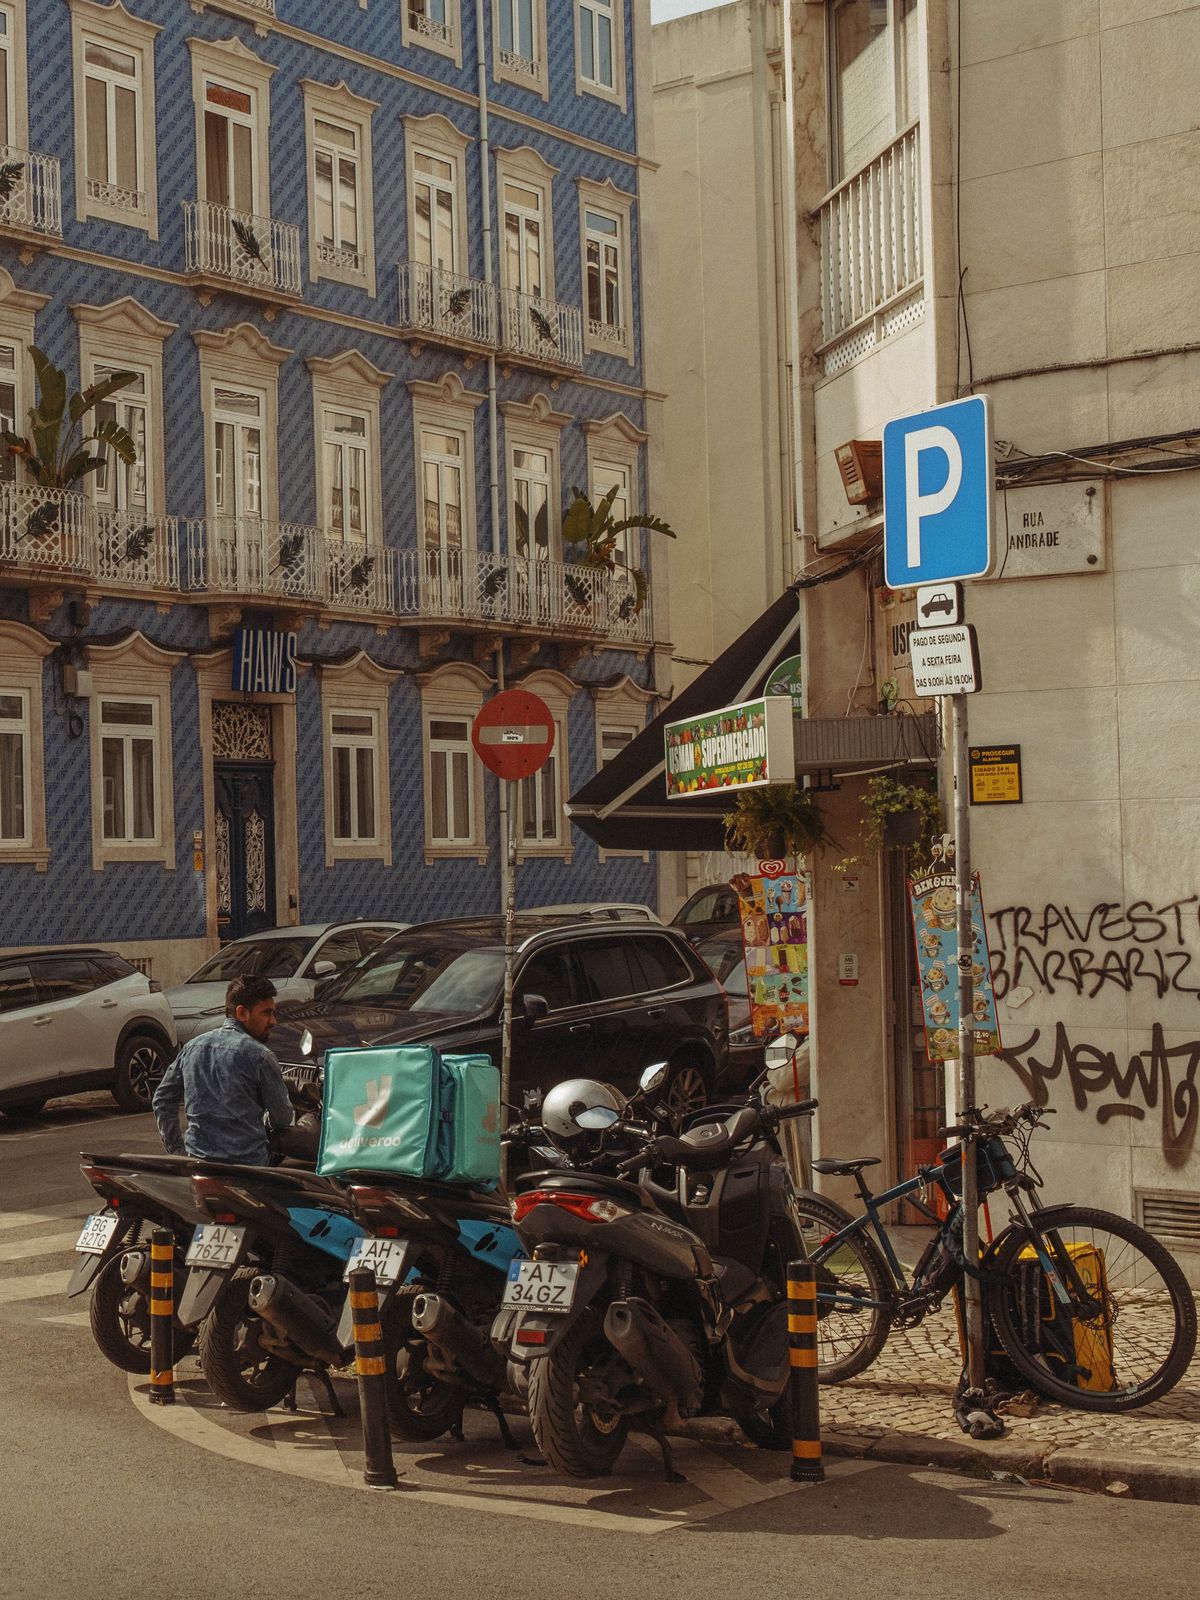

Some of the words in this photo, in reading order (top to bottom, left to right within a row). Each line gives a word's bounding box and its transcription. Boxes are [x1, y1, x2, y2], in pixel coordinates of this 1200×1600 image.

[905, 425, 963, 568] P
[1023, 511, 1045, 528] RUA
[1009, 531, 1060, 550] ANDRADE
[913, 637, 928, 647] PAGO
[929, 636, 937, 645] DE
[938, 633, 966, 644] SEGUNDA
[239, 629, 298, 693] HAWS
[922, 658, 927, 667] A
[927, 656, 946, 666] SEXTA
[945, 654, 962, 665] FEIRA
[916, 679, 927, 688] DAS
[669, 743, 695, 775] USMAN
[701, 726, 766, 768] SUPERMERCADO
[339, 1134, 402, 1149] deliveroo
[92, 1218, 108, 1232] BG
[80, 1232, 107, 1248] 82TG
[209, 1228, 227, 1244] AI
[194, 1243, 234, 1261] 76ZT
[365, 1241, 393, 1259] AH
[527, 1263, 559, 1283] AT
[511, 1283, 567, 1305] 34GZ
